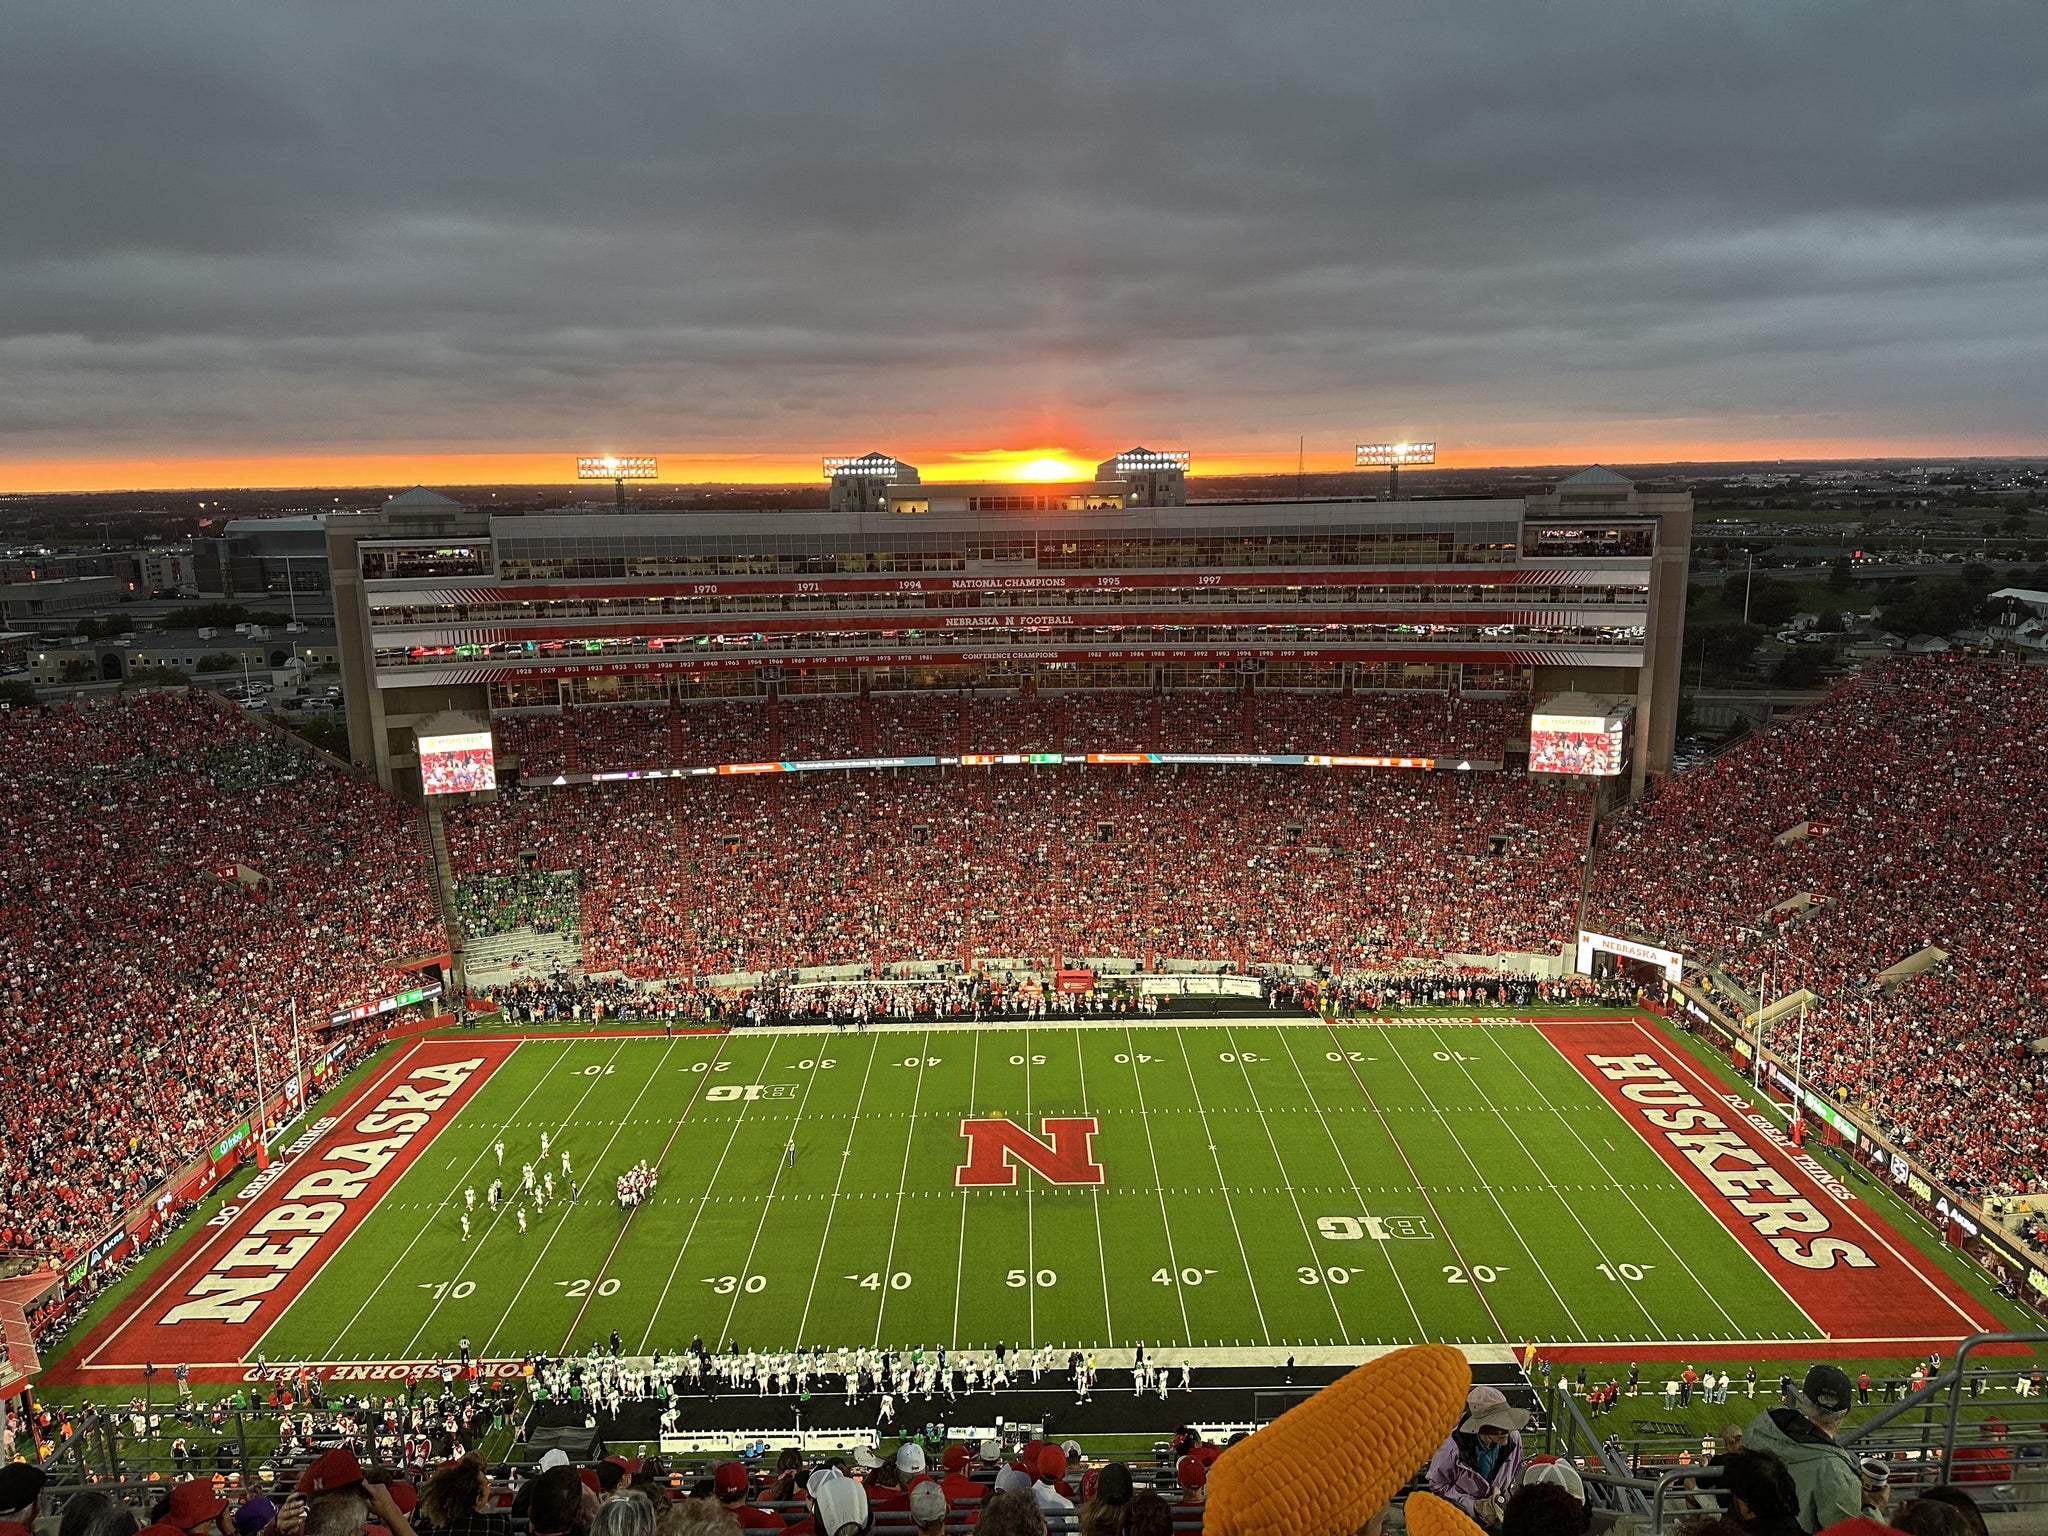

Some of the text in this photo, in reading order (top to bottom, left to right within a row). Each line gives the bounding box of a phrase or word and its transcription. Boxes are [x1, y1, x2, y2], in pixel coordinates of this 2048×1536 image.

[693, 576, 1221, 594] 1970 1971 1994 NATIONAL CHAMPIONS 1995 1997
[946, 615, 1074, 626] NEBRASKA N FOOTBALL
[962, 652, 1011, 660] CONFERENCE
[1012, 651, 1058, 659] CHAMPIONS
[225, 868, 234, 877] N
[1582, 935, 1679, 965] N NEBRASKA N
[955, 1117, 1105, 1187] N
[1722, 1094, 1858, 1201] DO GREAT THINGS
[1585, 1053, 1881, 1270] HUSKERS
[206, 1116, 337, 1227] DO GREAT THINGS
[208, 1166, 217, 1181] N
[157, 1057, 488, 1327] NEBRASKA
[102, 1230, 125, 1255] AKRS
[858, 1271, 912, 1291] 40
[1005, 1269, 1058, 1287] 50
[1151, 1267, 1203, 1286] 40
[1296, 1266, 1350, 1285] 30
[1441, 1265, 1497, 1283] 20
[1595, 1263, 1645, 1281] 10
[430, 1281, 477, 1299] 10
[564, 1278, 622, 1297] 20
[713, 1275, 767, 1294] 30
[329, 1364, 462, 1381] OSBORNE
